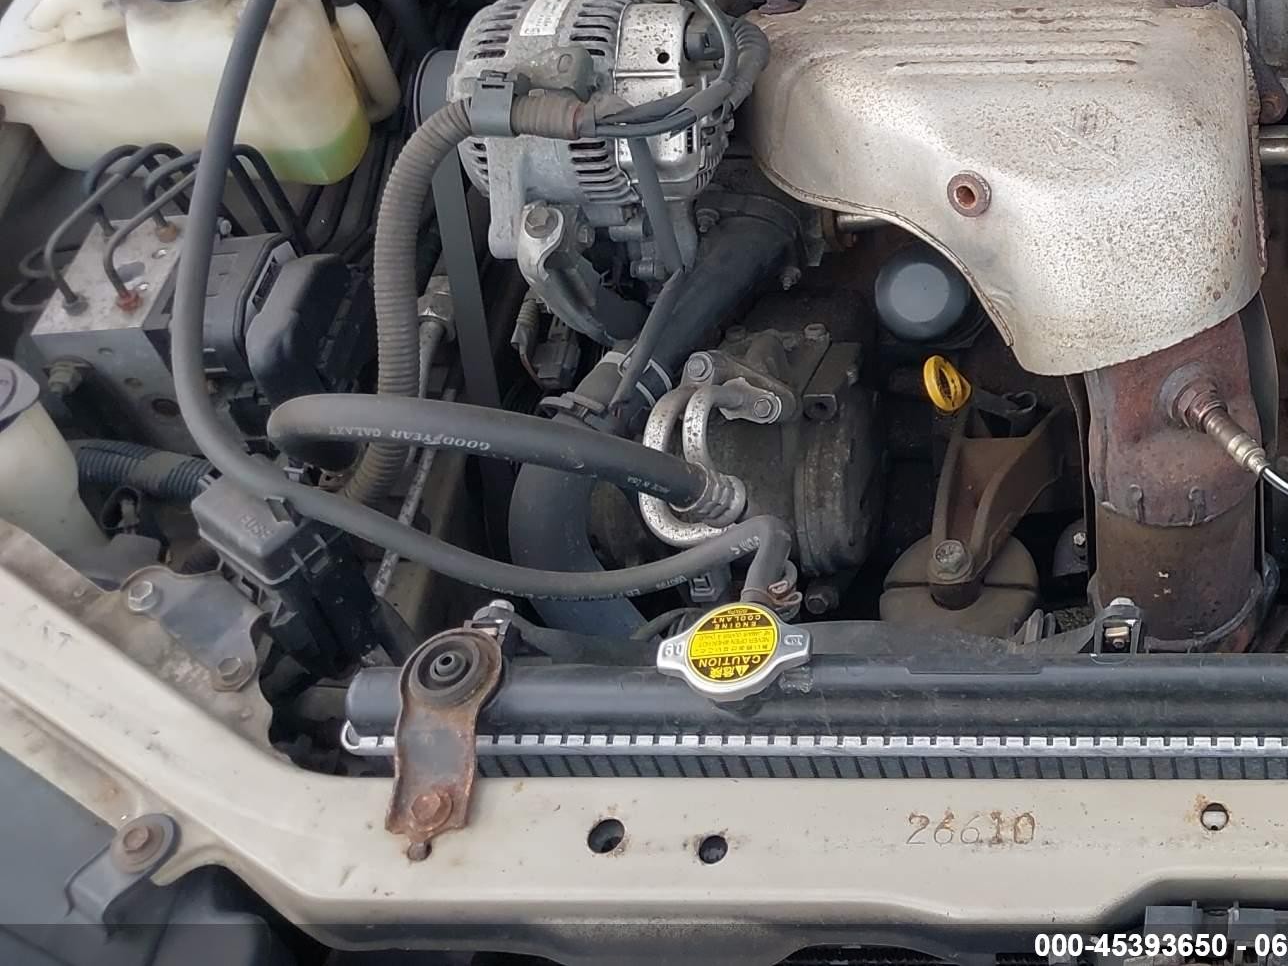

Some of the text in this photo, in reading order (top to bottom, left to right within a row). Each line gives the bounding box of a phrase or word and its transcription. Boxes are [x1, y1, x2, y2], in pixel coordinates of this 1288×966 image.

[711, 614, 761, 624] COOLANT
[713, 621, 757, 630] ENGINE
[698, 655, 761, 668] CAUTION
